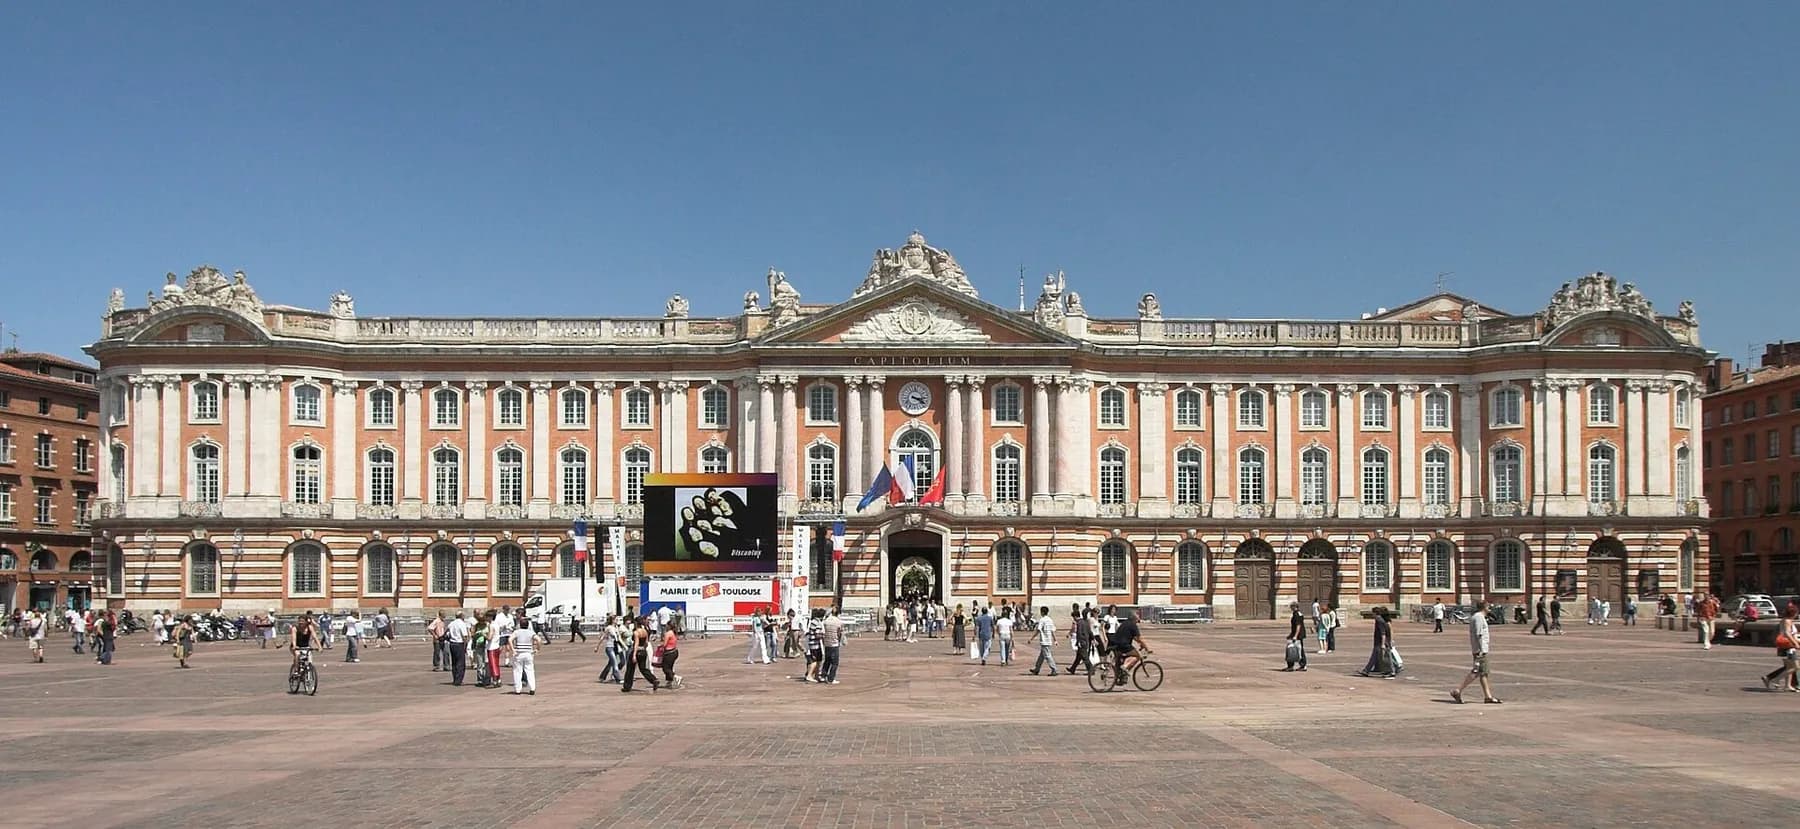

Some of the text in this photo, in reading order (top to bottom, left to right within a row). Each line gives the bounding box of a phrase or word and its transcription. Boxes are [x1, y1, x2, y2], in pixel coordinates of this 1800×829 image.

[854, 356, 970, 365] CAPITOLIUM
[660, 588, 761, 596] MAIRIE DE TOULOUSE
